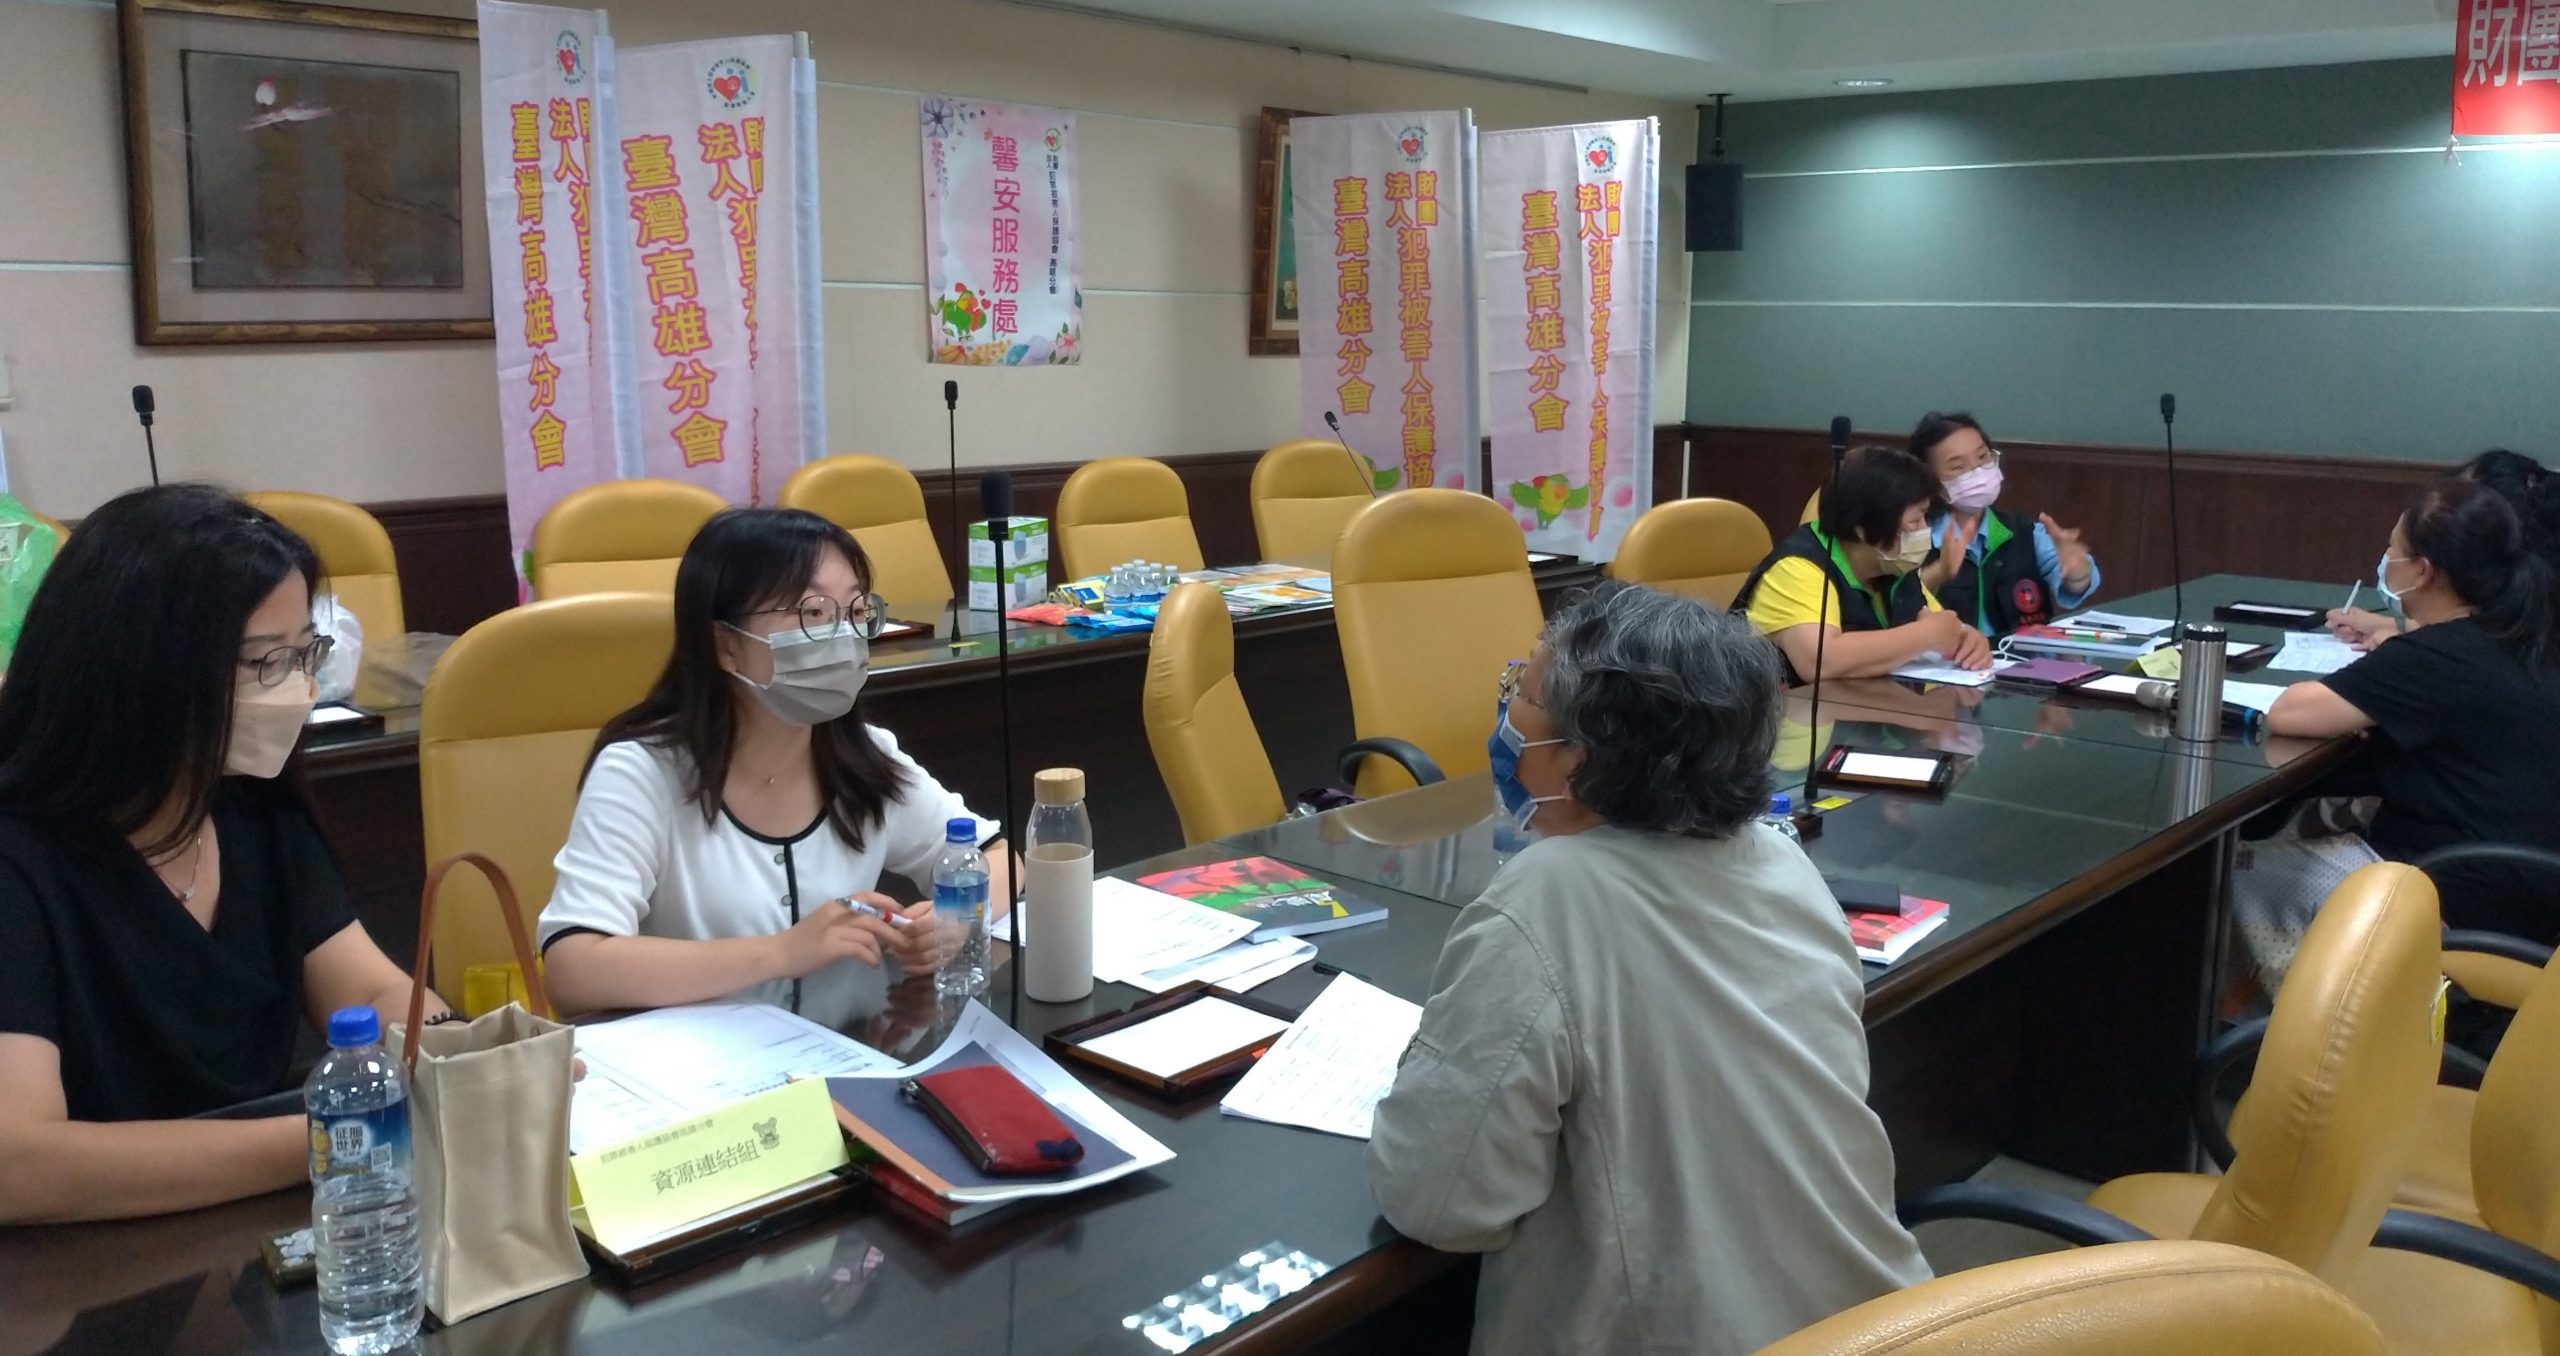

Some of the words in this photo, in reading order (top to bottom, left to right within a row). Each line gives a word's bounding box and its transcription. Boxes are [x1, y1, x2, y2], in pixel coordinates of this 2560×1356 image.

[510, 102, 566, 470] 臺灣高雄分會
[622, 135, 726, 468] 臺灣高雄分會
[991, 136, 1021, 334] 馨安服務處
[1334, 176, 1374, 416] 臺灣高雄分會
[1522, 190, 1568, 433] 臺灣高雄分會
[651, 1138, 761, 1194] 資源連結組
